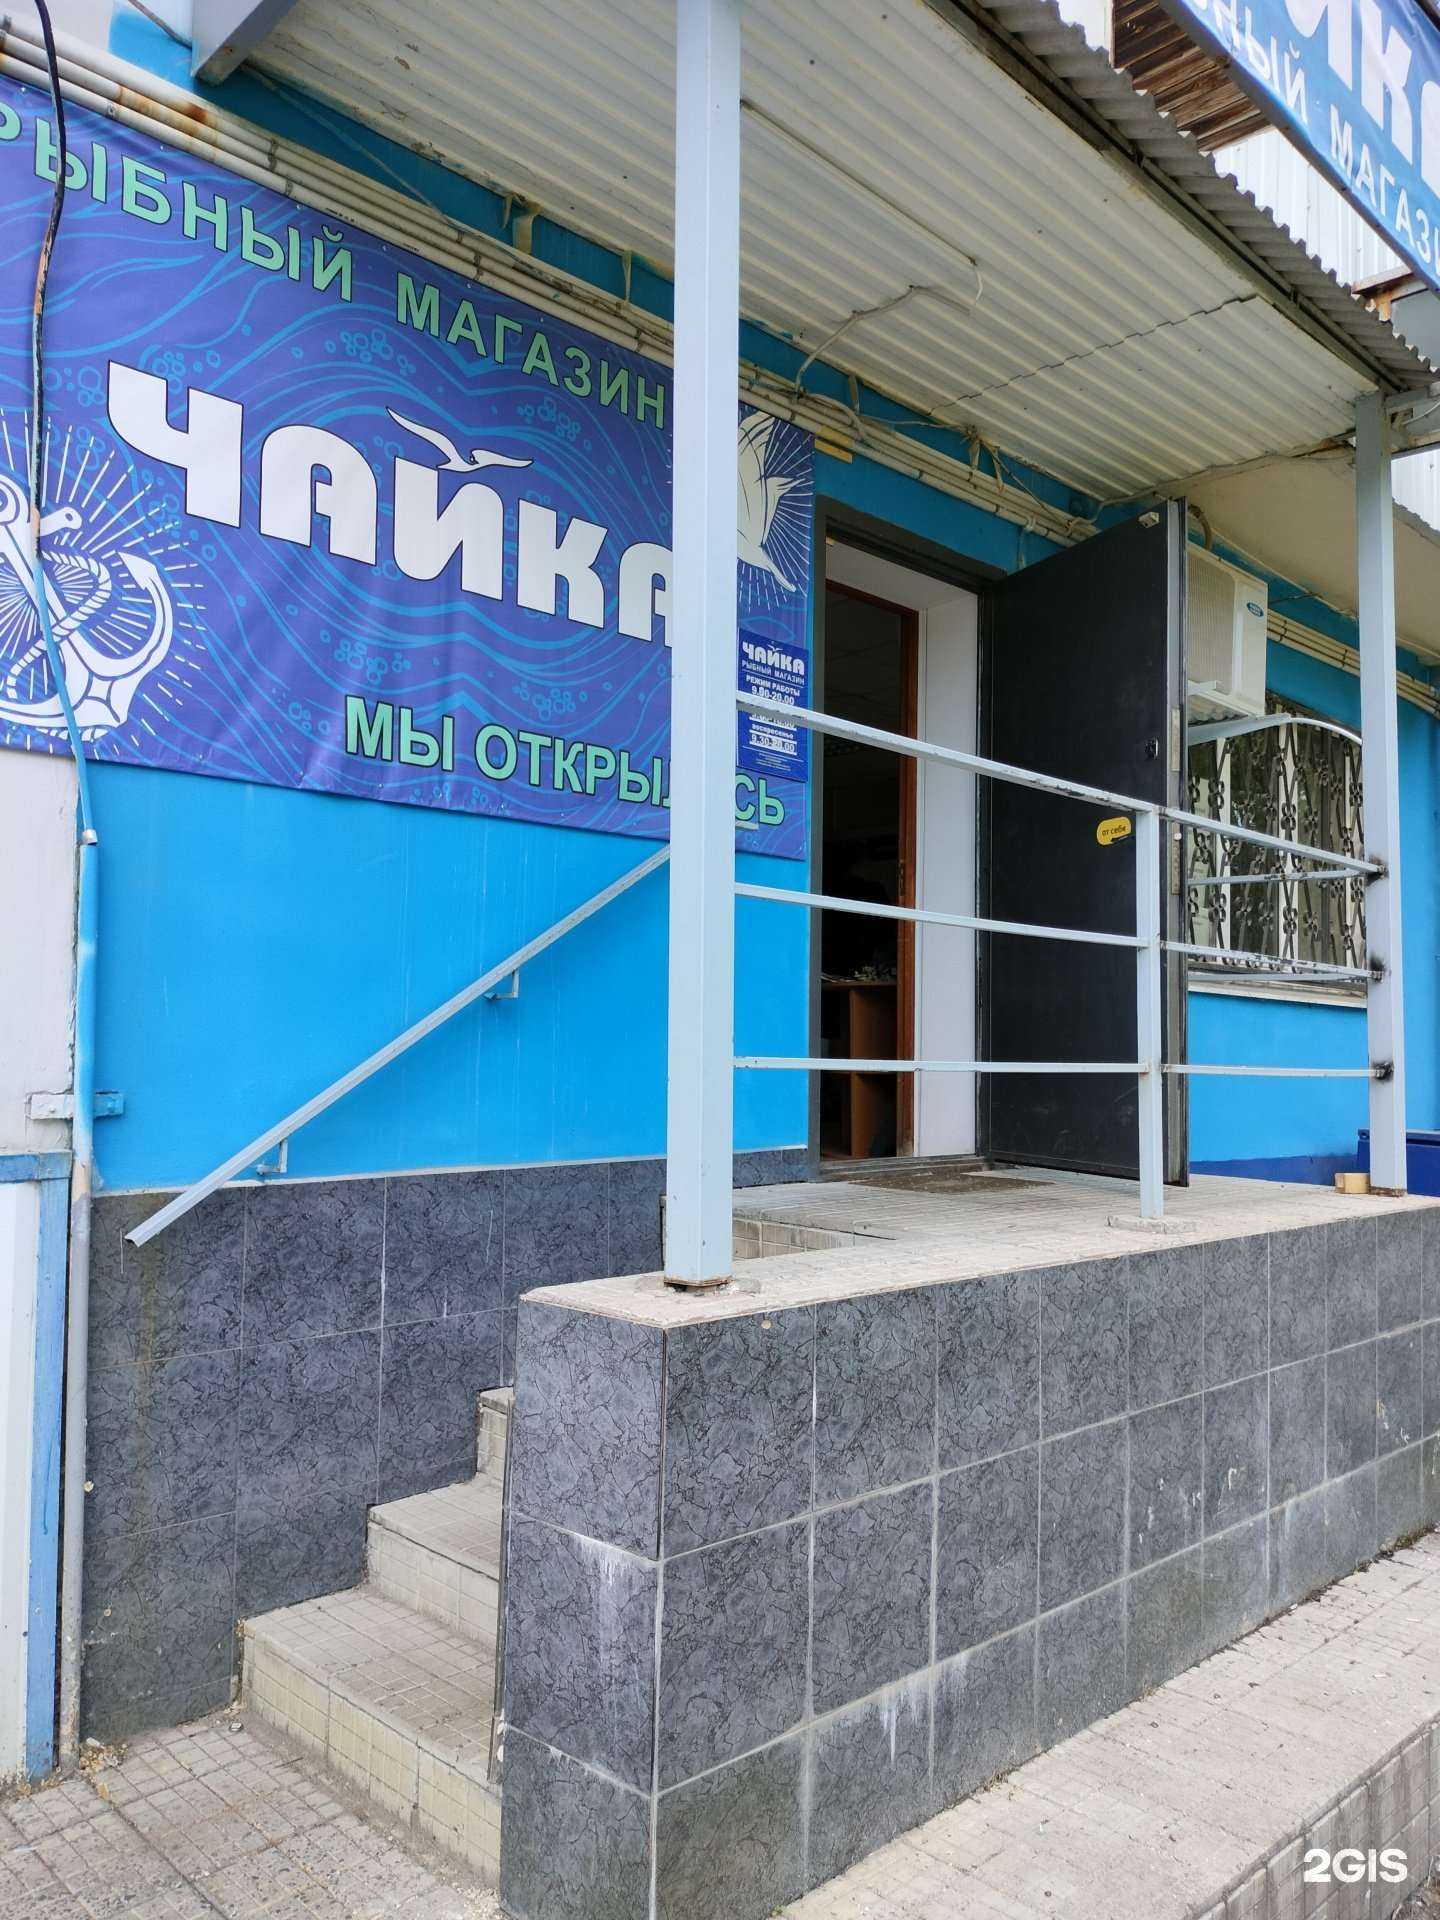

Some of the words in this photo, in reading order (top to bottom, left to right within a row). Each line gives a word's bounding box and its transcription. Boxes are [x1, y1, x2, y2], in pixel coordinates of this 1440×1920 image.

[396, 272, 666, 430] МАГАЗИН
[107, 360, 673, 649] ЧАЙКА
[742, 641, 805, 676] ЧАЙКА
[746, 675, 771, 689] РЕЖИМ
[772, 682, 801, 697] РАБОТЫ
[774, 670, 805, 686] МАГАЗИН
[344, 694, 455, 772] МЫ
[474, 724, 785, 827] ОТКРЫСЬ
